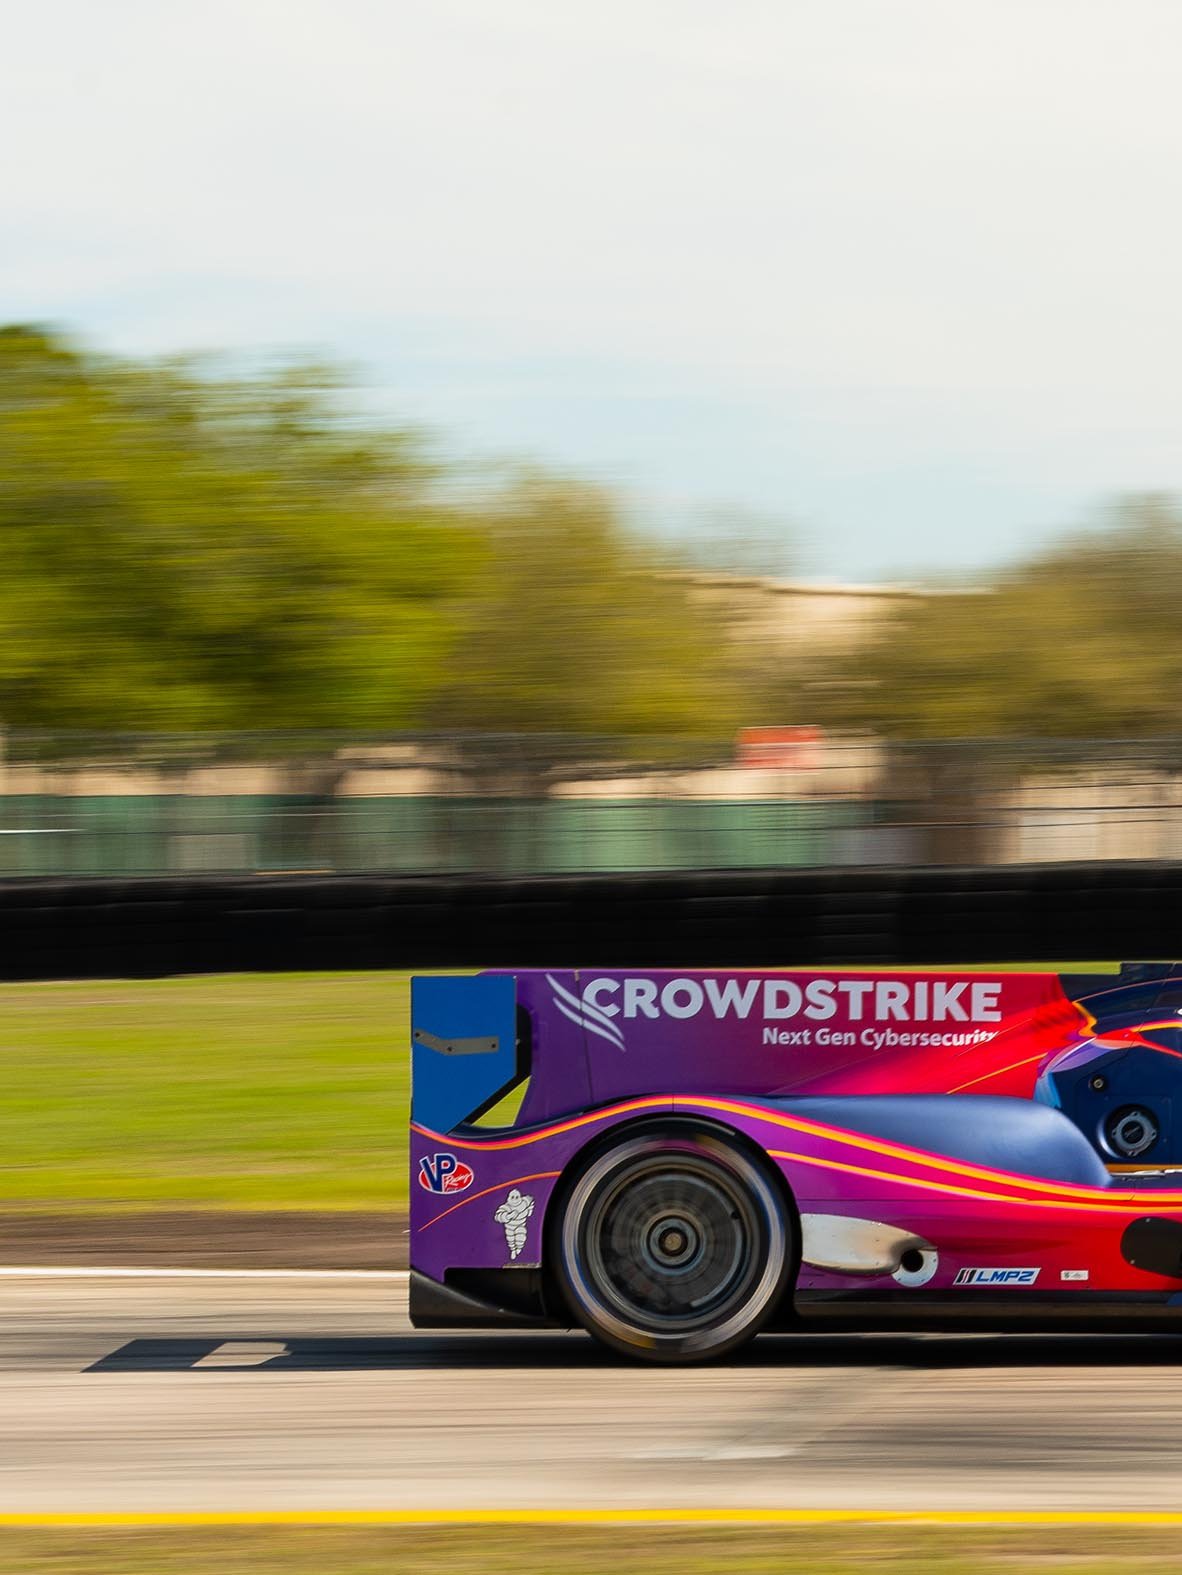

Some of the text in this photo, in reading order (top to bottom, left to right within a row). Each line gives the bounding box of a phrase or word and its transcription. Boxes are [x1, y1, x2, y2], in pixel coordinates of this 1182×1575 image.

[582, 977, 1002, 1022] CROWDSTRIKE
[763, 1027, 998, 1050] Next Gen Cybersecurity
[419, 1153, 457, 1192] VP
[975, 1270, 1035, 1282] LMP2
